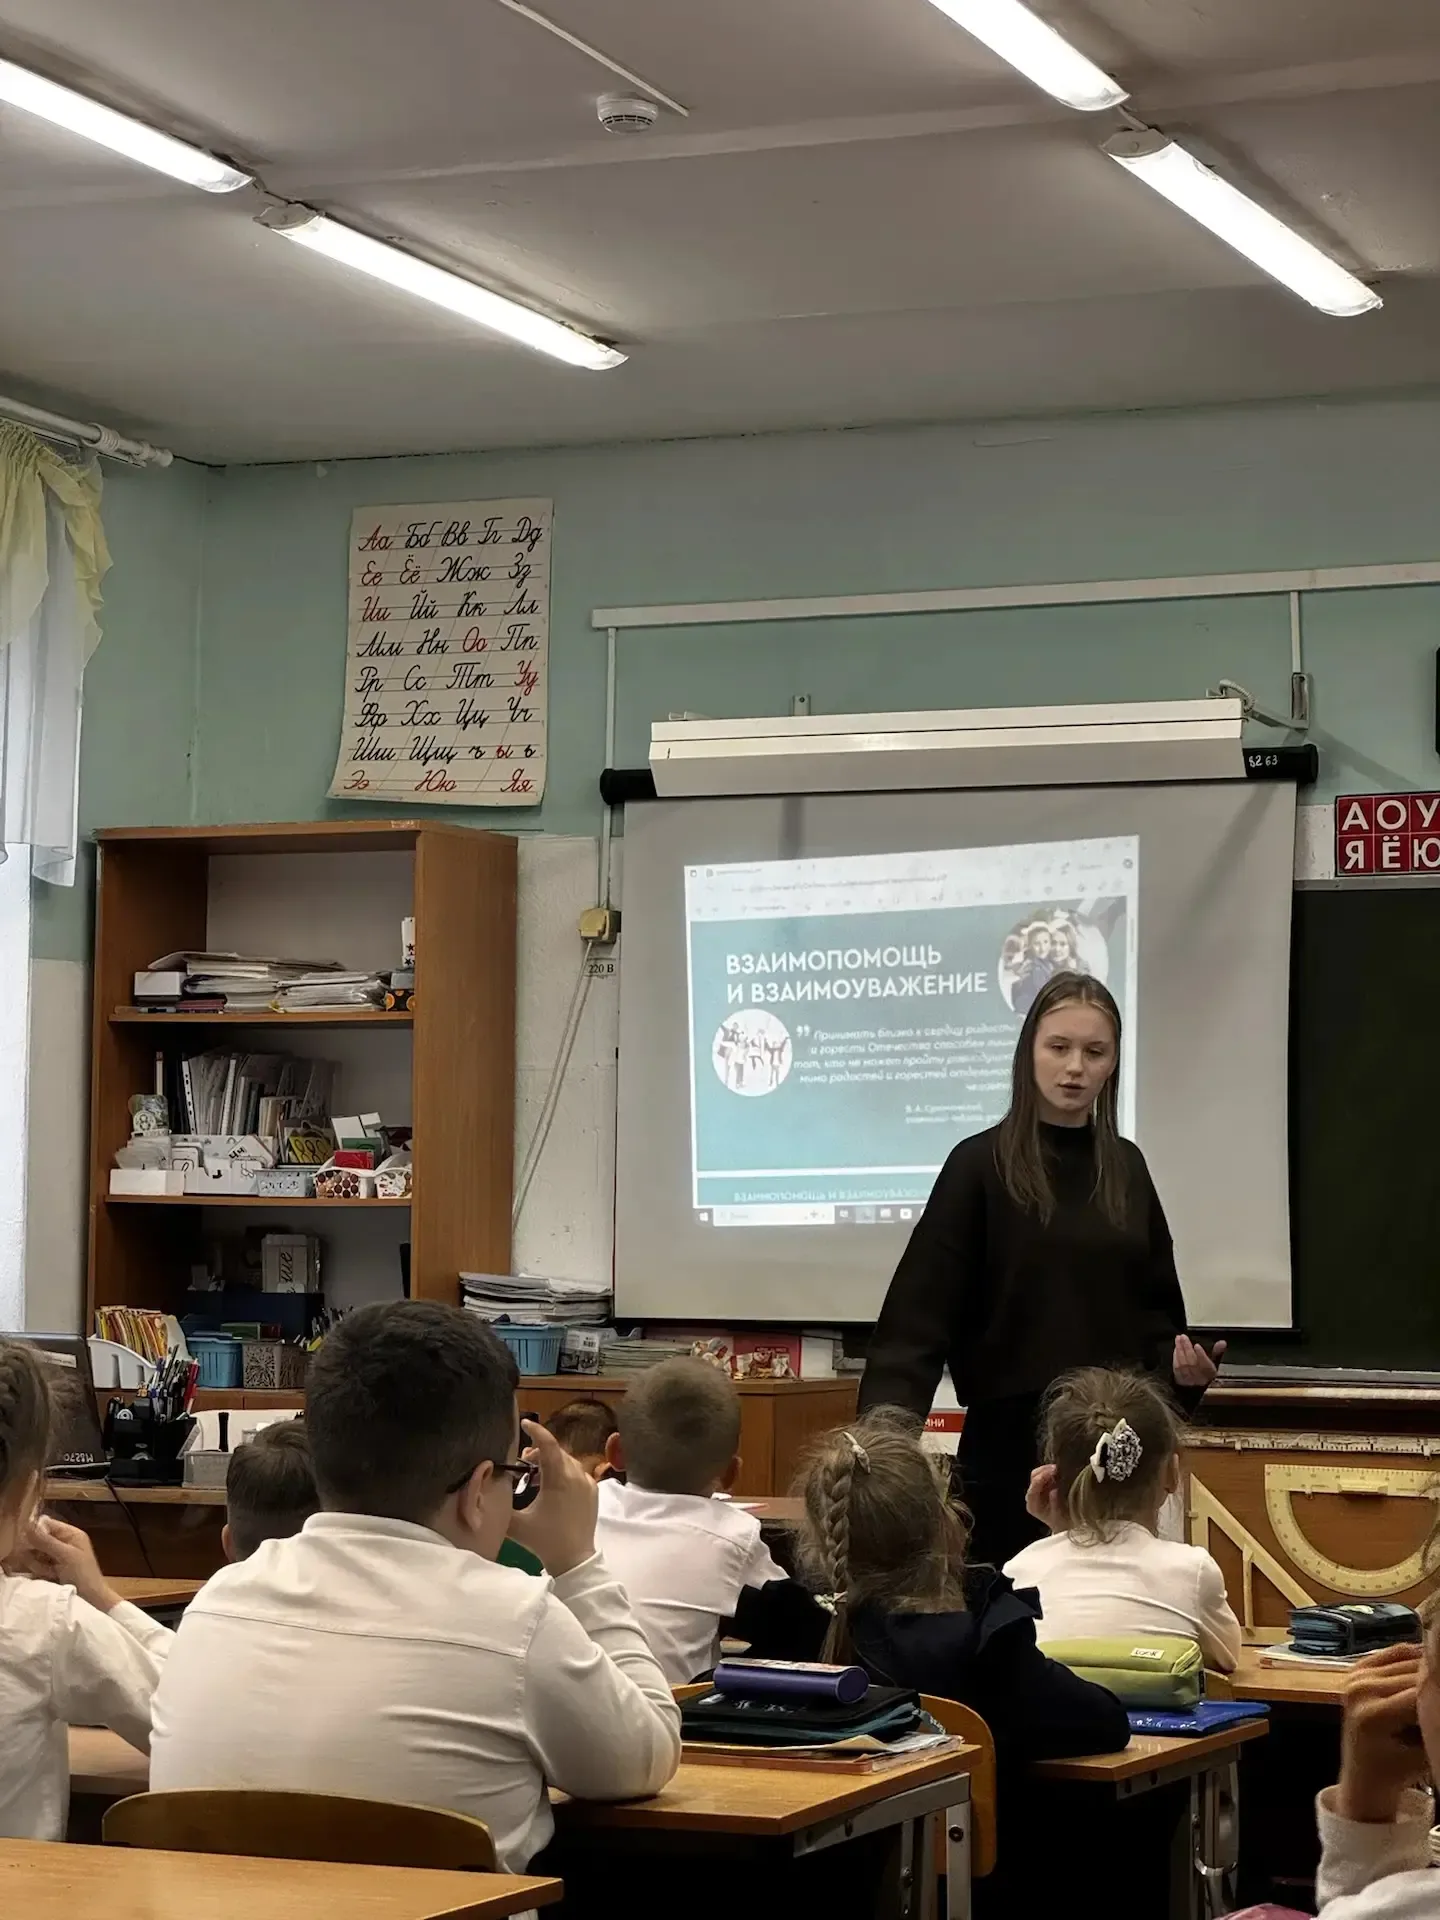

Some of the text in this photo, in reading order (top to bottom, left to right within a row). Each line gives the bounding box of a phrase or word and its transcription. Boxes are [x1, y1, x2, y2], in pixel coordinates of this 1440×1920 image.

[358, 524, 394, 551] Аа
[405, 520, 443, 548] Бб
[441, 520, 471, 547] Вв
[511, 516, 543, 552] Дд
[361, 552, 532, 588] Ее Ёё Жж Зз
[361, 588, 540, 621] Ии Йй Кк Лл
[356, 623, 538, 657] Мм Нн Оо Пп
[354, 660, 539, 702] Рр Сс Тт Уу
[354, 697, 533, 736] Фф Хх Цц Чч
[352, 736, 396, 761] Шш
[408, 735, 458, 767] Щщ
[495, 744, 514, 759] ы
[343, 768, 533, 793] Ээ Юю Яя
[1342, 802, 1369, 831] А
[1377, 800, 1407, 831] О
[1344, 840, 1365, 870] Я
[1383, 835, 1401, 868] Ё
[726, 944, 942, 975] ВЗАИМОПОМОЩЬ
[727, 972, 988, 1004] И ВЗАИМОУВАЖЕНИЕ
